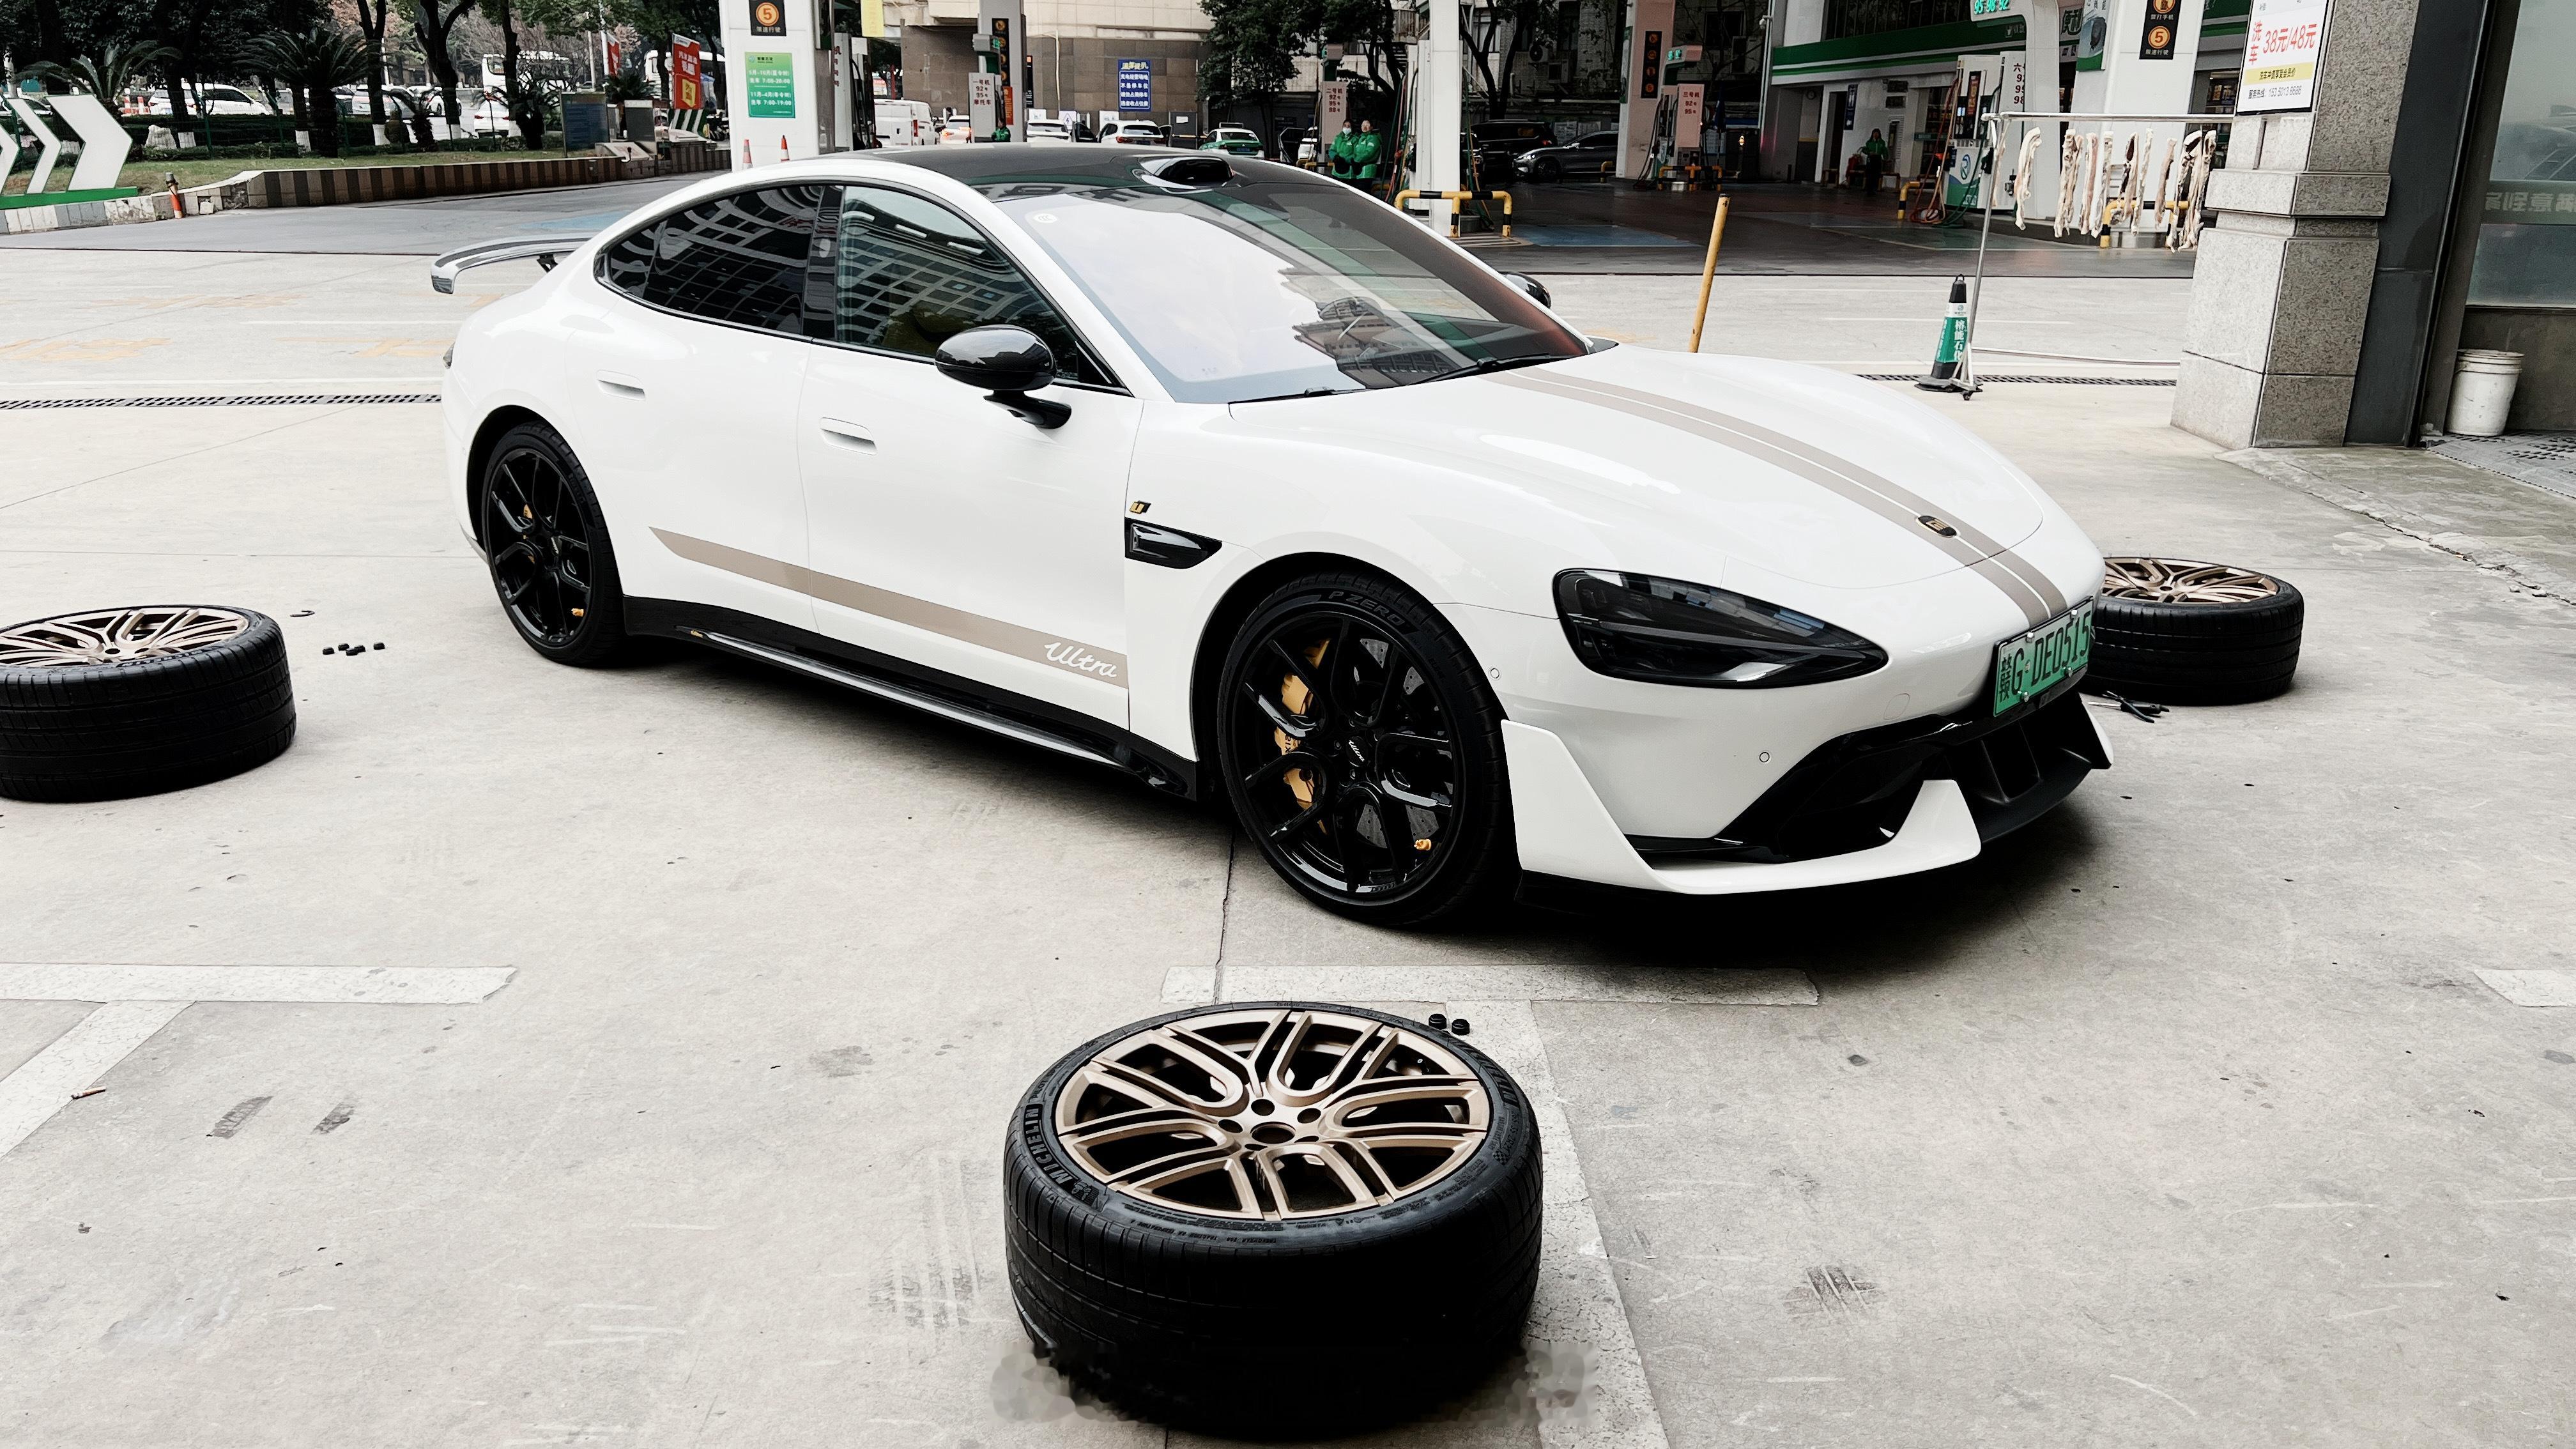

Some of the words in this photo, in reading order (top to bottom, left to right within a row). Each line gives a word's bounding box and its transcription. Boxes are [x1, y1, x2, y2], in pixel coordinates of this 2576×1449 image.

[763, 8, 772, 20] 5
[2155, 31, 2164, 43] 5
[2248, 20, 2263, 65] 洗车
[2263, 24, 2317, 54] 38元/48元
[1329, 590, 1344, 599] P
[1346, 594, 1406, 626] ZERO
[1044, 642, 1117, 678] Ultra
[1024, 1107, 1074, 1184] MICHELIN
